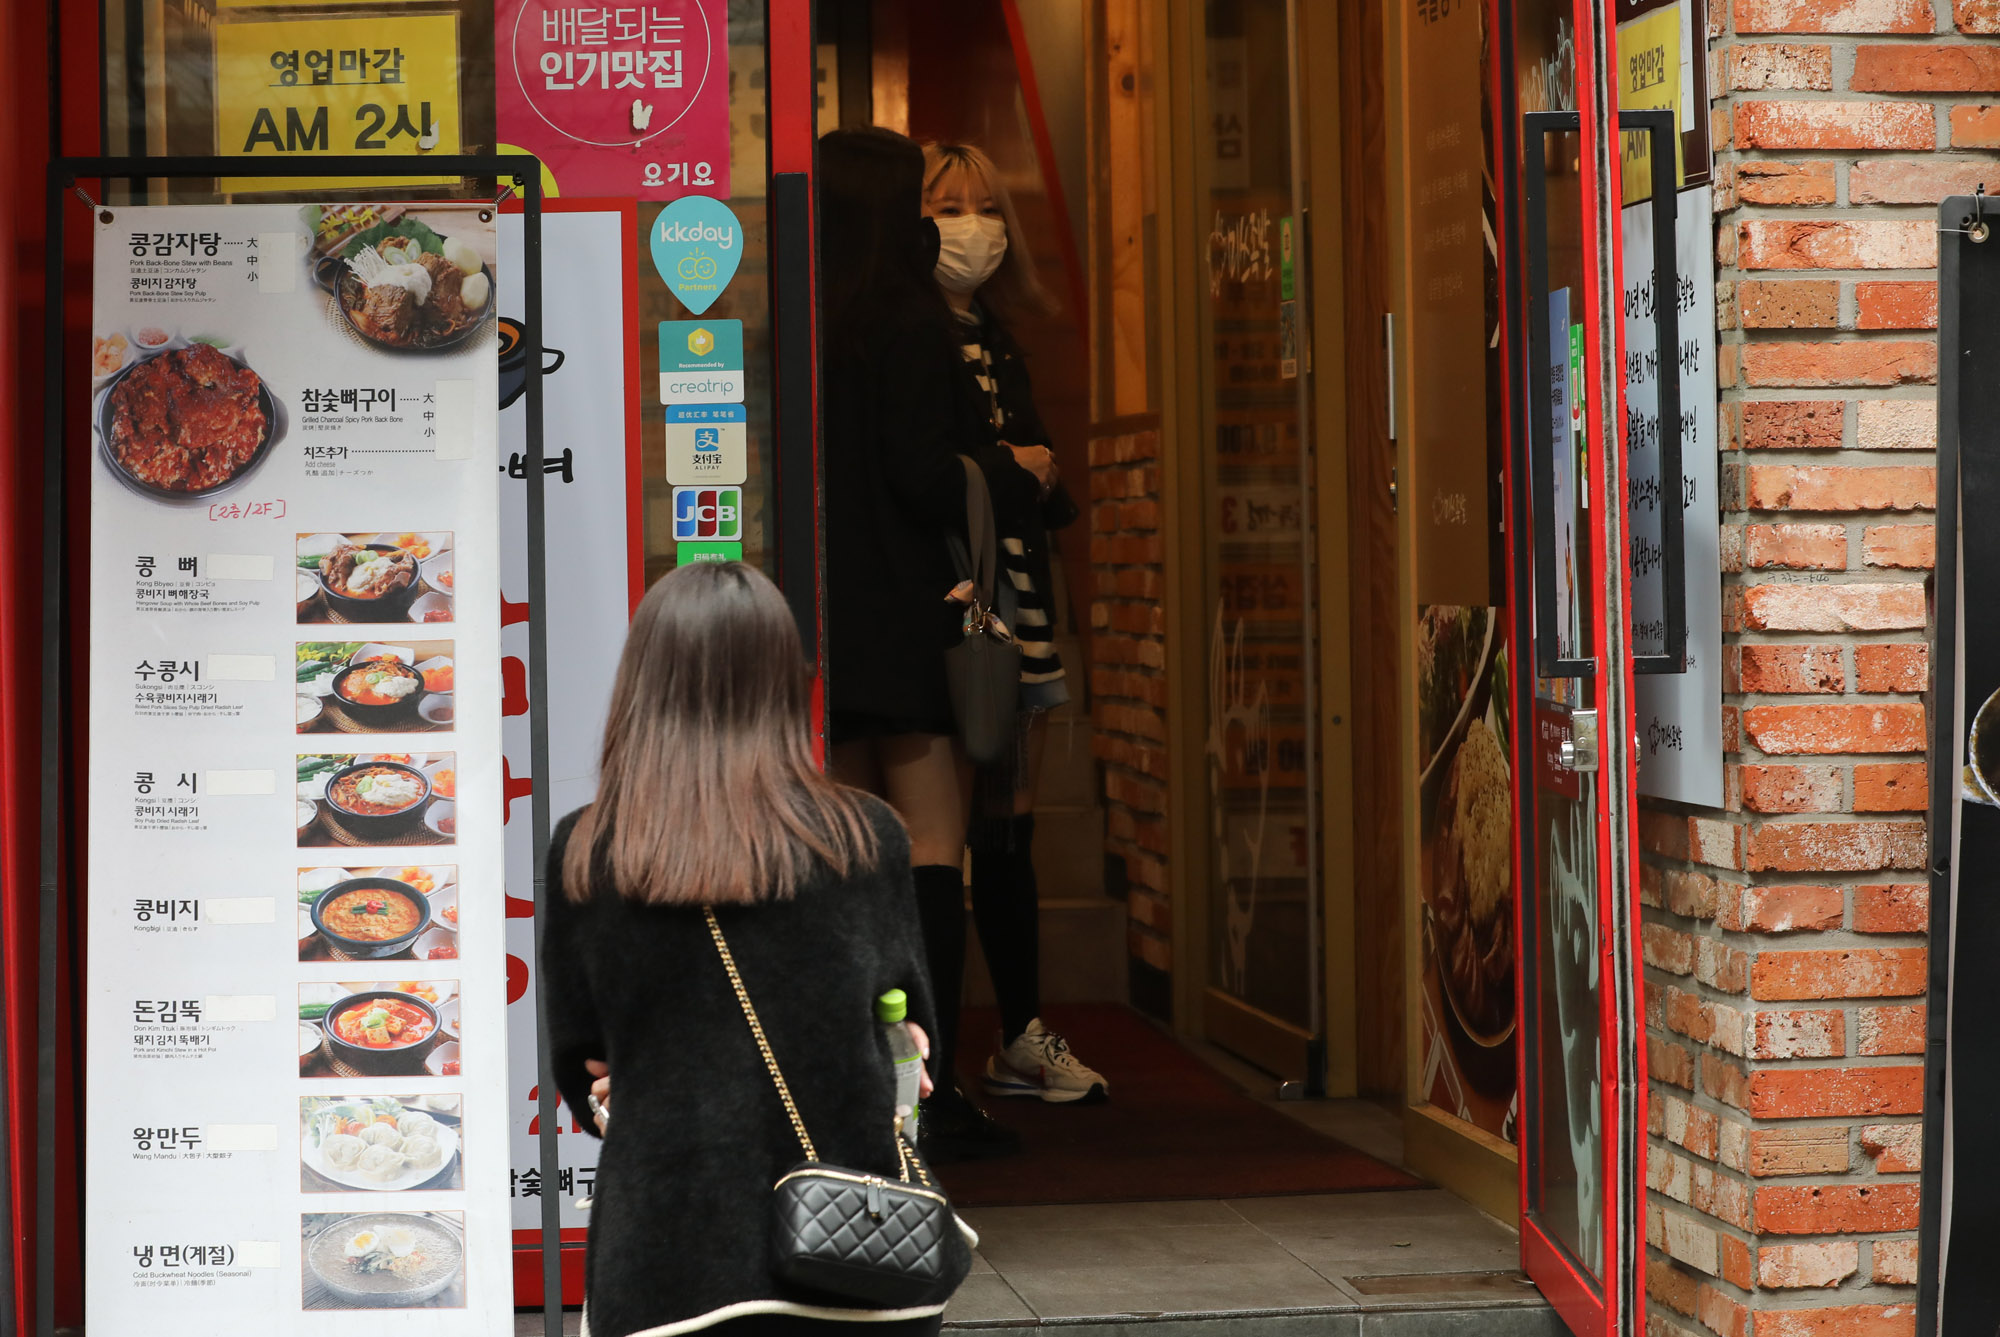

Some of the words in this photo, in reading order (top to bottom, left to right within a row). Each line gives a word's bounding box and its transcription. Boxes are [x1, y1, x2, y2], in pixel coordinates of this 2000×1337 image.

[543, 6, 684, 45] 배달되는
[270, 47, 404, 85] 영업마감
[540, 50, 683, 90] 인기맛집
[1630, 44, 1664, 92] 영업마감
[243, 106, 328, 152] AM
[355, 101, 431, 150] 2시
[642, 162, 714, 186] 요기요
[129, 233, 221, 256] 콩감자탕
[247, 237, 257, 248] 大
[661, 221, 733, 249] kkday
[247, 256, 257, 265] 中
[248, 272, 258, 281] 小
[670, 378, 733, 396] creatrip
[302, 388, 396, 412] 참숯뼈구이
[423, 393, 434, 403] 大
[345, 416, 360, 424] Spicy
[423, 411, 434, 421] 中
[424, 427, 435, 437] 小
[304, 447, 348, 459] 치즈추가
[692, 454, 722, 464] 支付宝
[677, 506, 736, 522] JCB
[136, 556, 156, 577] 콩
[178, 556, 197, 577] 뼈
[136, 589, 165, 600] 콩비지
[168, 589, 209, 600] 뼈해장국
[134, 660, 200, 682] 수콩시
[135, 693, 217, 703] 수육콩비지시래기
[134, 772, 155, 794] 콩
[177, 773, 196, 794] 시
[134, 806, 164, 817] 콩비지
[168, 806, 198, 817] 시래기
[133, 899, 198, 921] 콩비지
[133, 1000, 202, 1023] 돈김뚝
[134, 1035, 154, 1046] 돼지
[157, 1035, 176, 1046] 김치
[179, 1035, 210, 1046] 뚝배기
[133, 1127, 202, 1150] 왕만두
